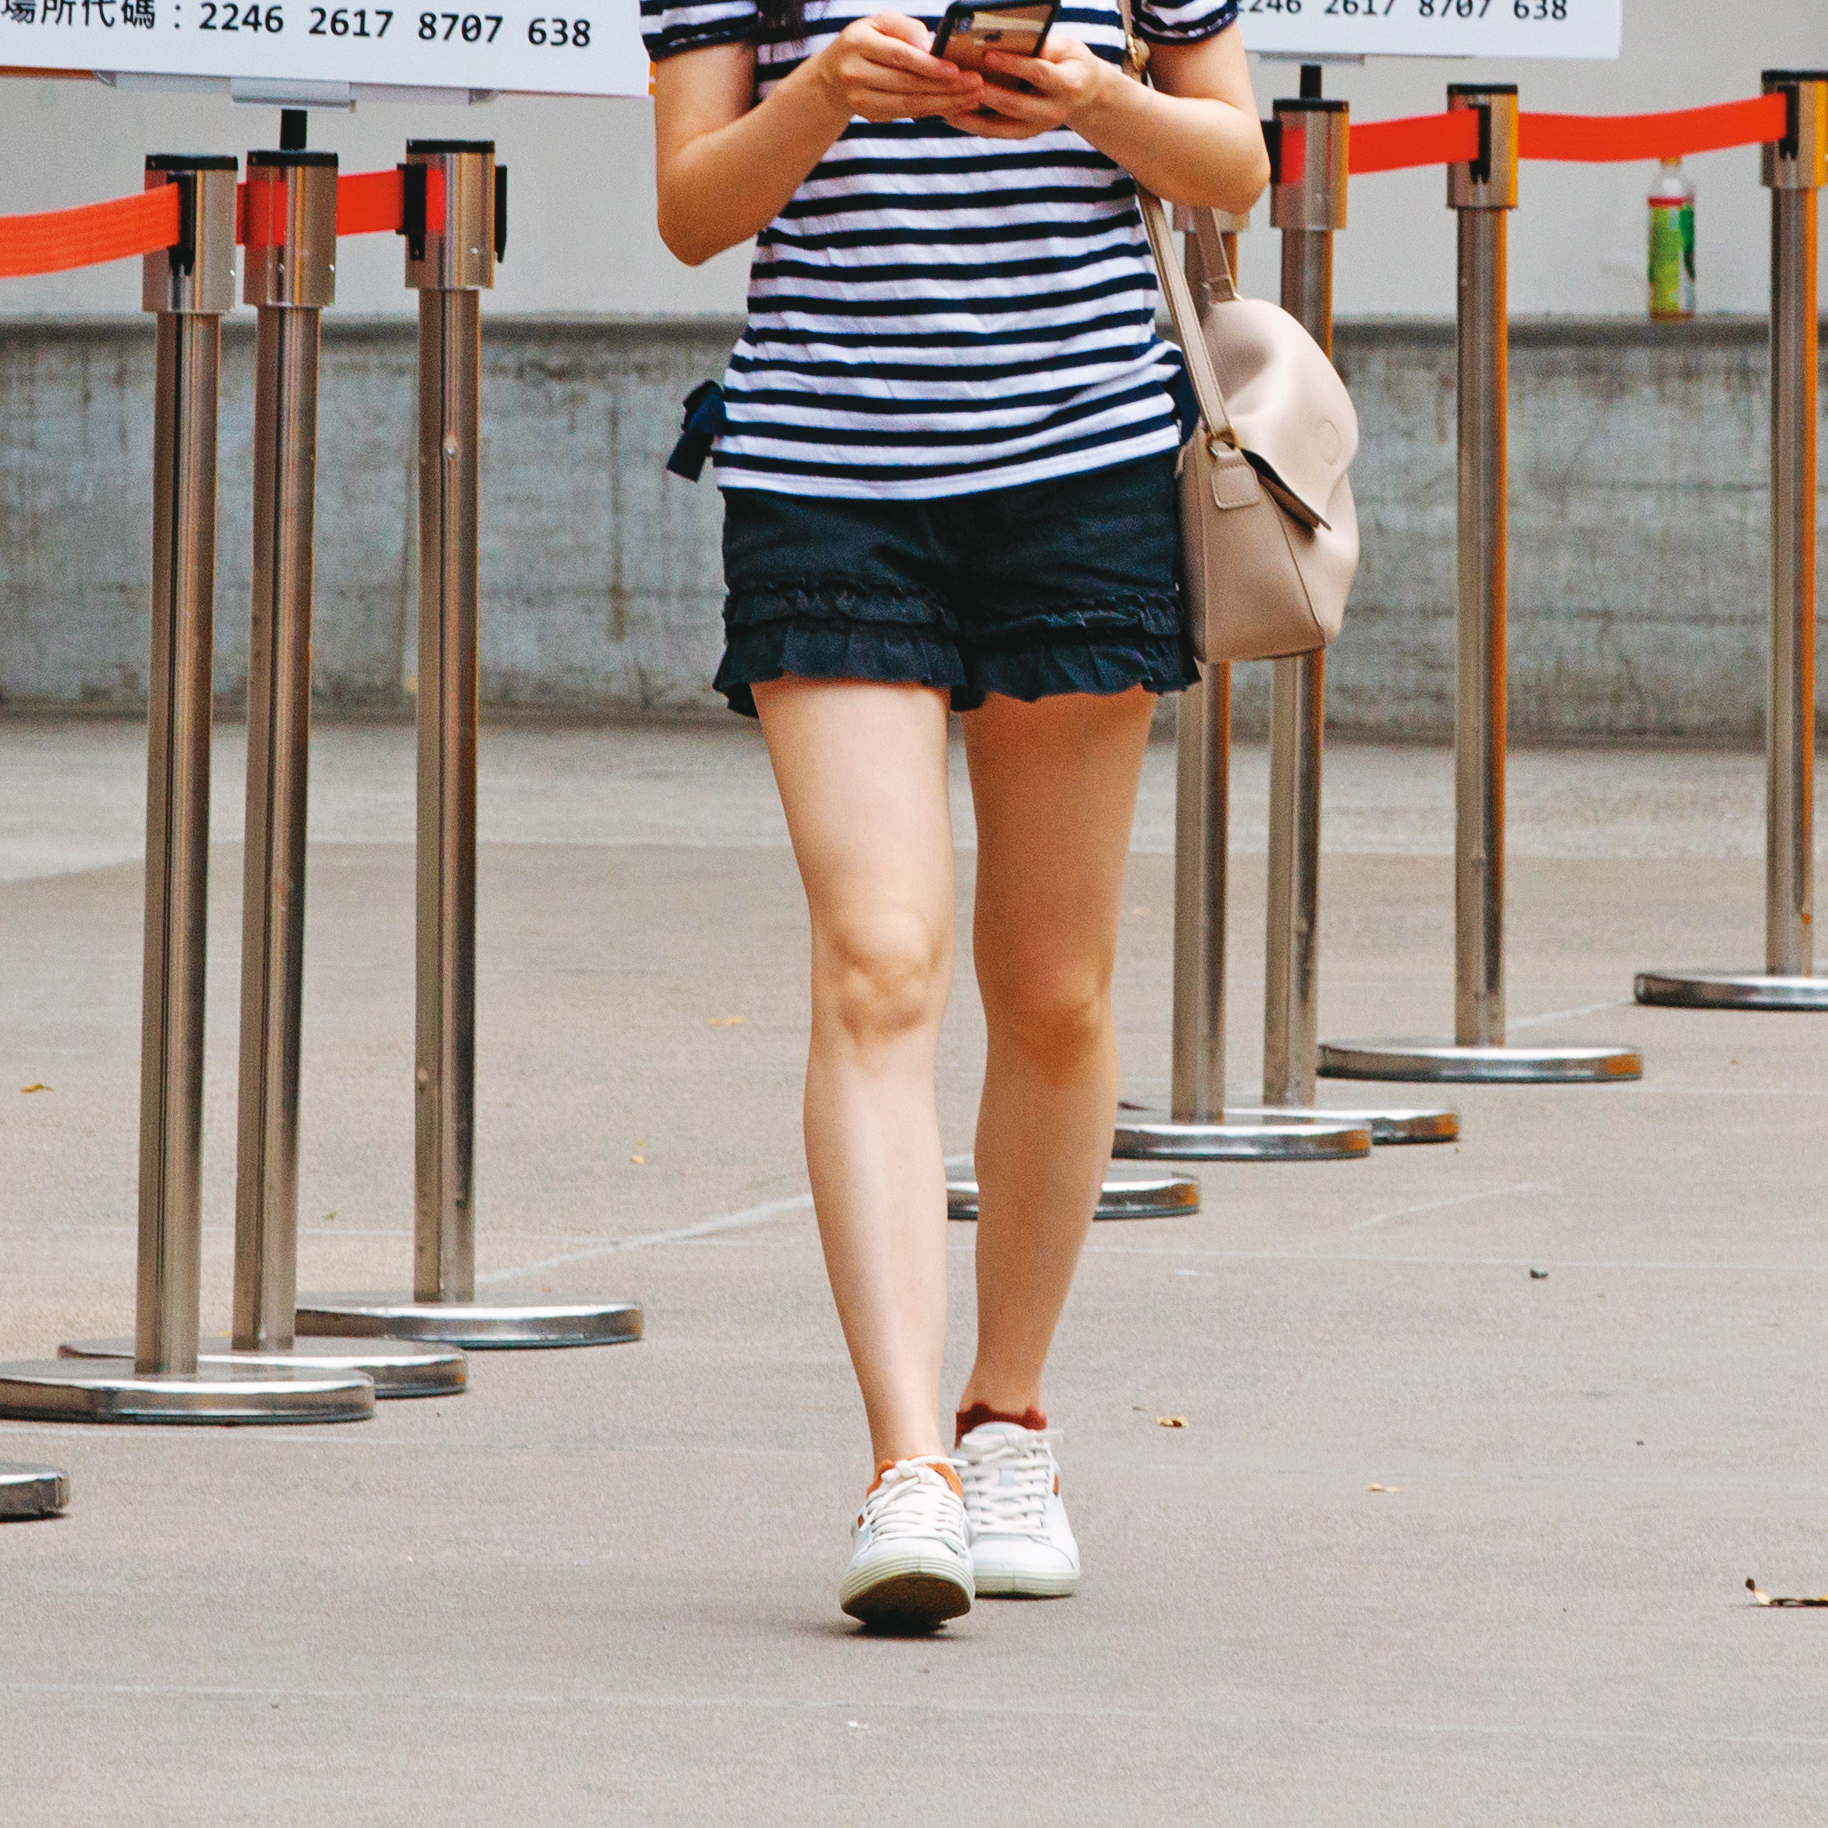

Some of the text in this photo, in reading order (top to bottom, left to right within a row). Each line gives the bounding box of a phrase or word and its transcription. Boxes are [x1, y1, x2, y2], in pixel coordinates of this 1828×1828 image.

[307, 5, 395, 39] 2617
[416, 10, 505, 45] 8707
[526, 16, 592, 49] 638
